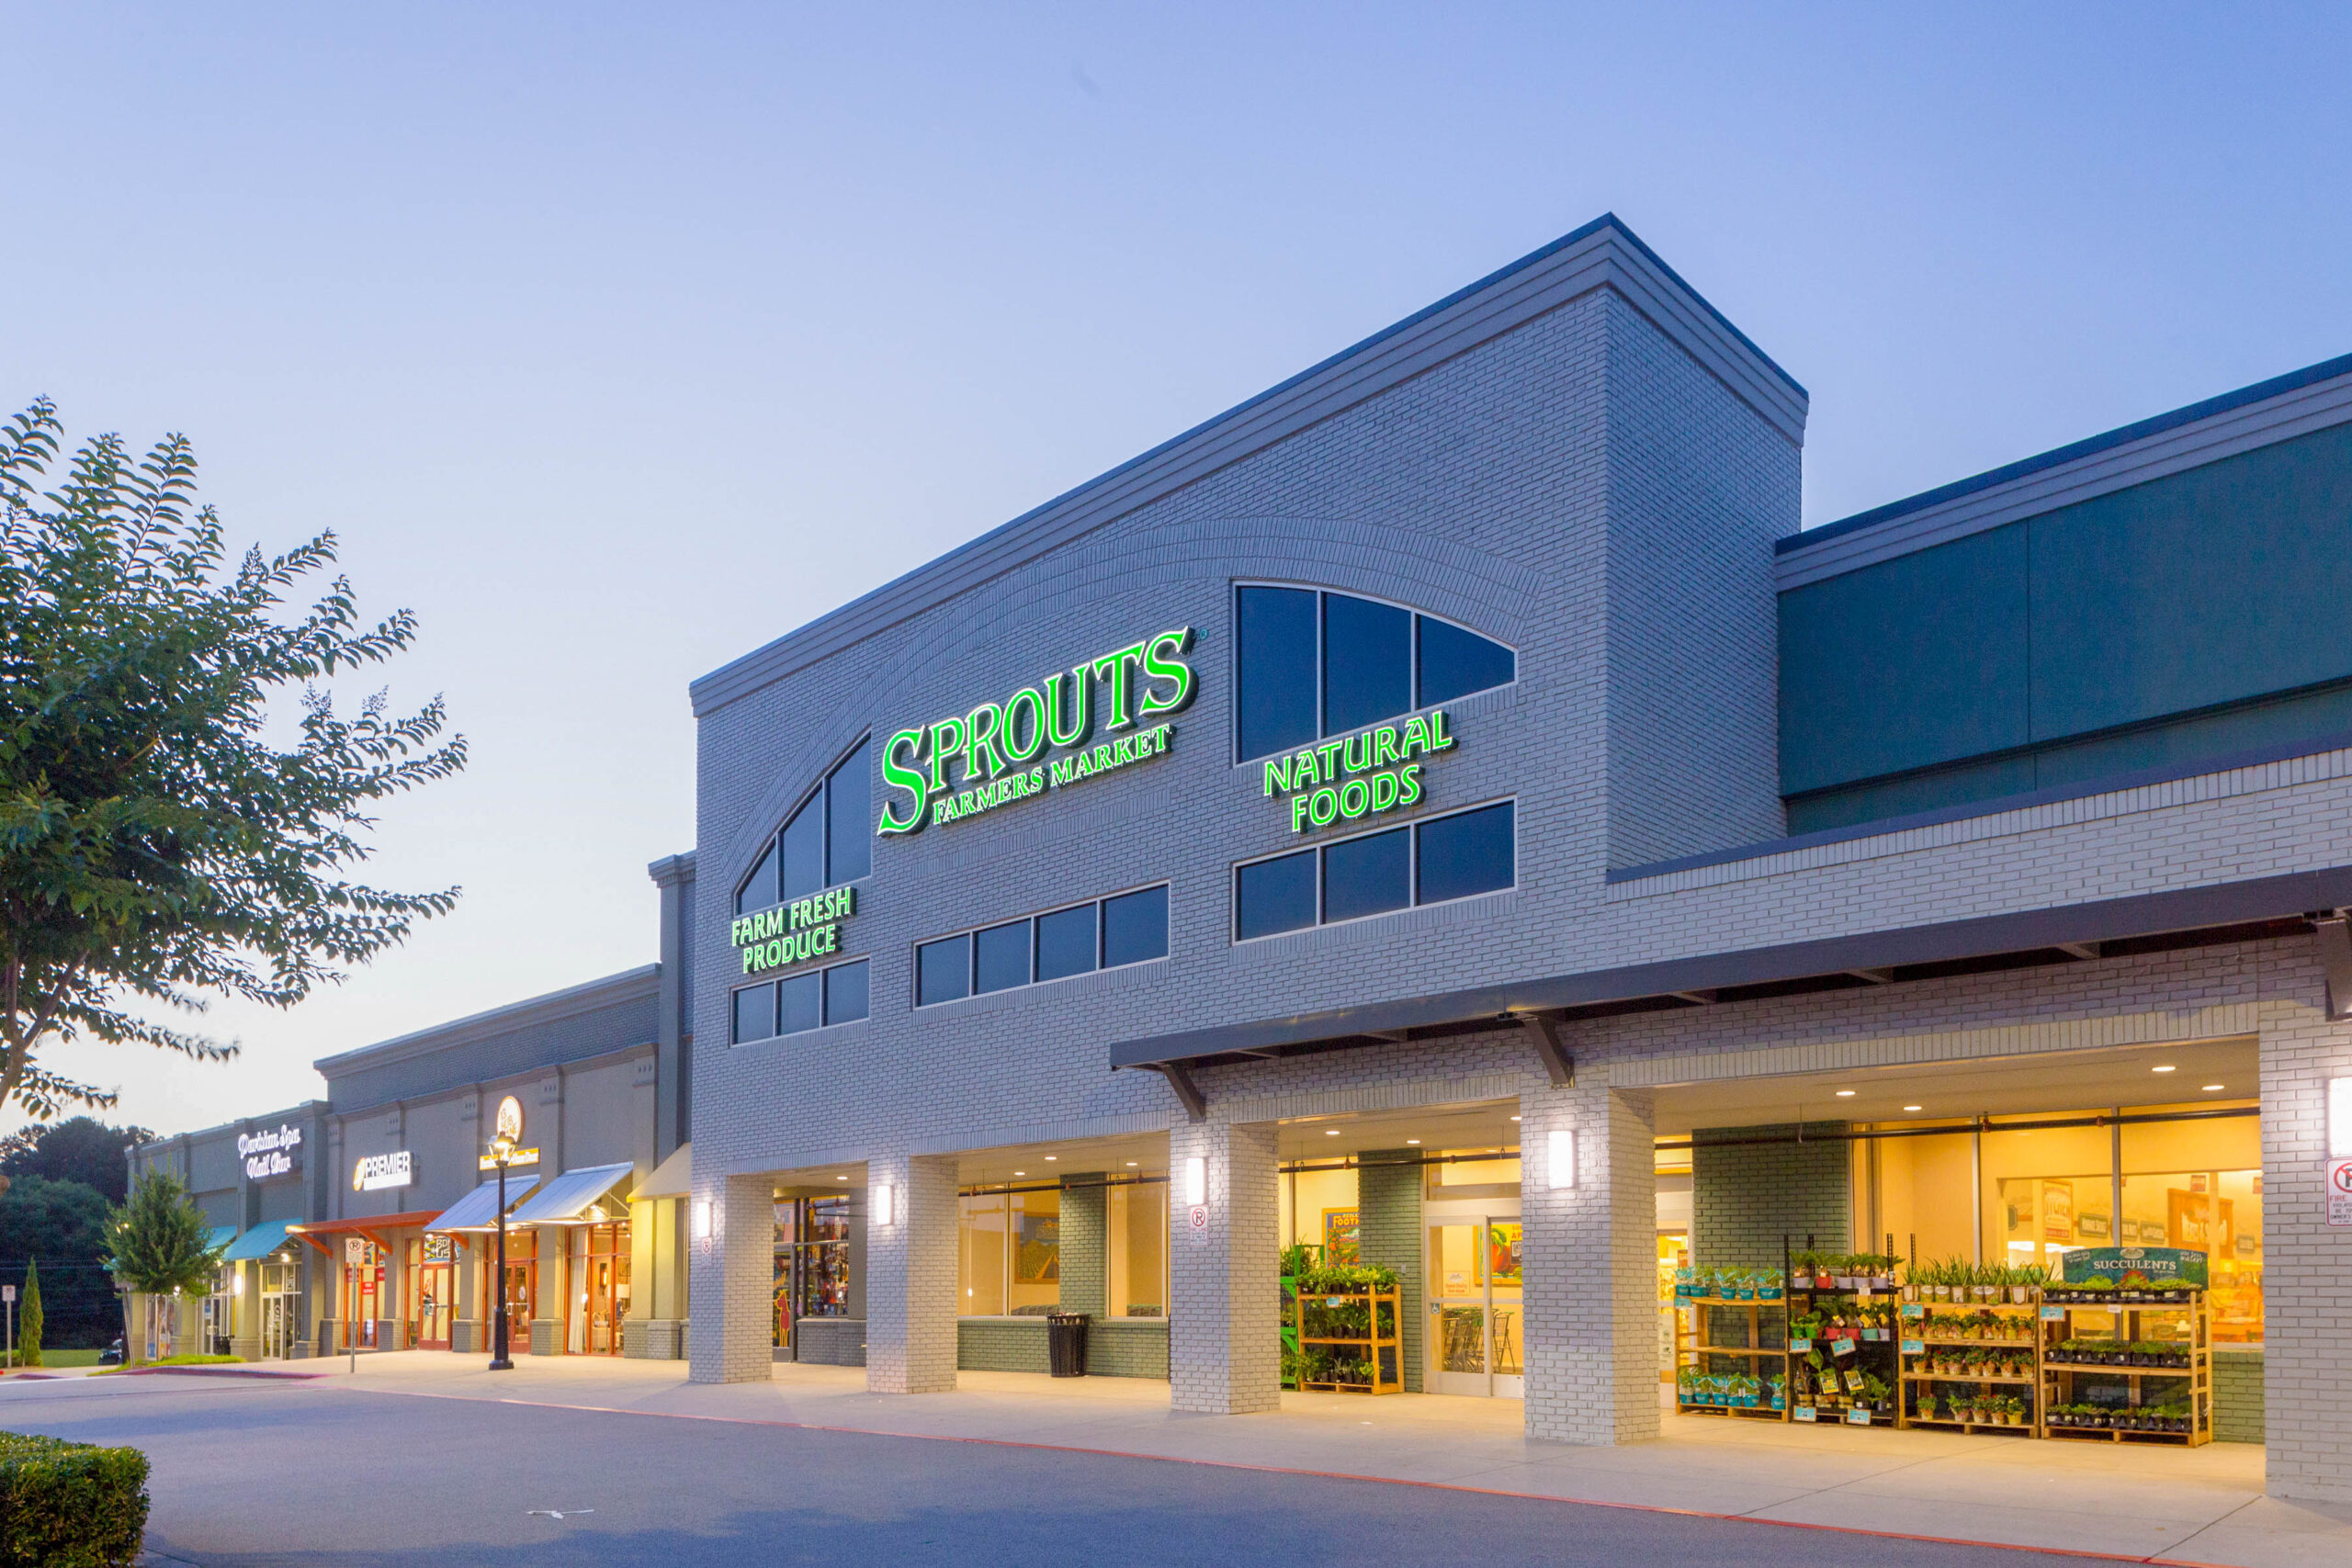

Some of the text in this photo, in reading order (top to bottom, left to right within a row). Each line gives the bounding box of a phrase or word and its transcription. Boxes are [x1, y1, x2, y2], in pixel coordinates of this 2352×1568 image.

[876, 626, 1190, 837] SPROUTS
[1264, 710, 1453, 796] NATURAL
[933, 723, 1170, 826] FARMERS MARKET
[1292, 764, 1419, 832] FOODS
[731, 886, 852, 947] FARM FRESH
[742, 923, 836, 974] PRODUCE
[238, 1124, 301, 1159] Parisian Spa
[246, 1151, 291, 1179] Nail Bar
[365, 1151, 411, 1179] PREMIER
[2093, 1259, 2177, 1270] SUCCULENTS
